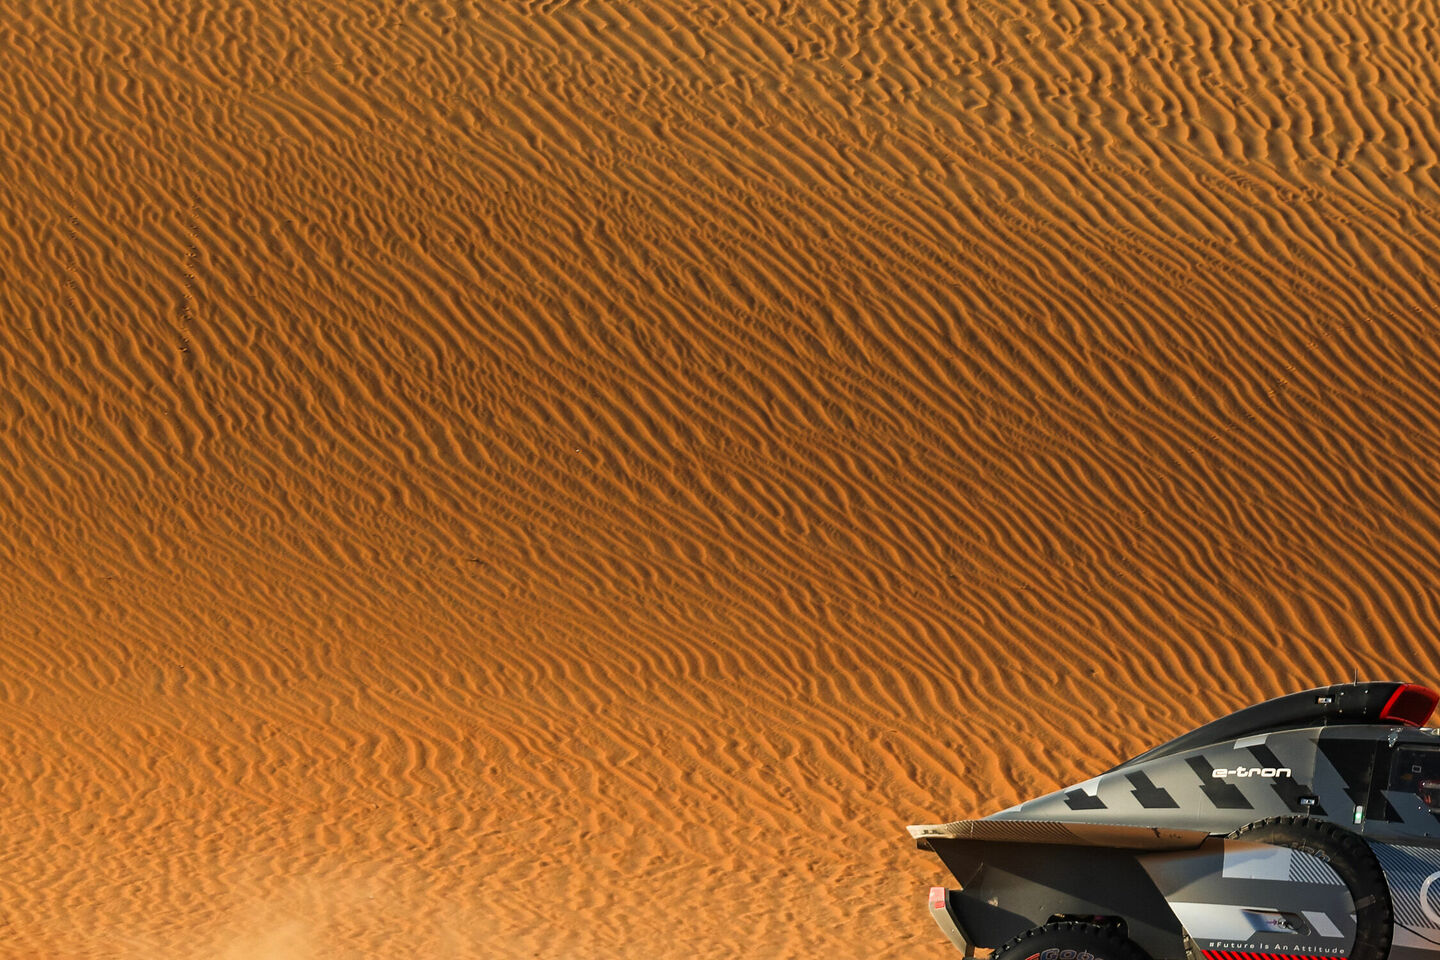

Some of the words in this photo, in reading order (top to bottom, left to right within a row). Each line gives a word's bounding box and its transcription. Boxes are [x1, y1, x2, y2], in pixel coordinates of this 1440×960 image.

[1212, 766, 1291, 778] e-tron
[1274, 943, 1288, 951] An
[1293, 944, 1345, 954] Attitude
